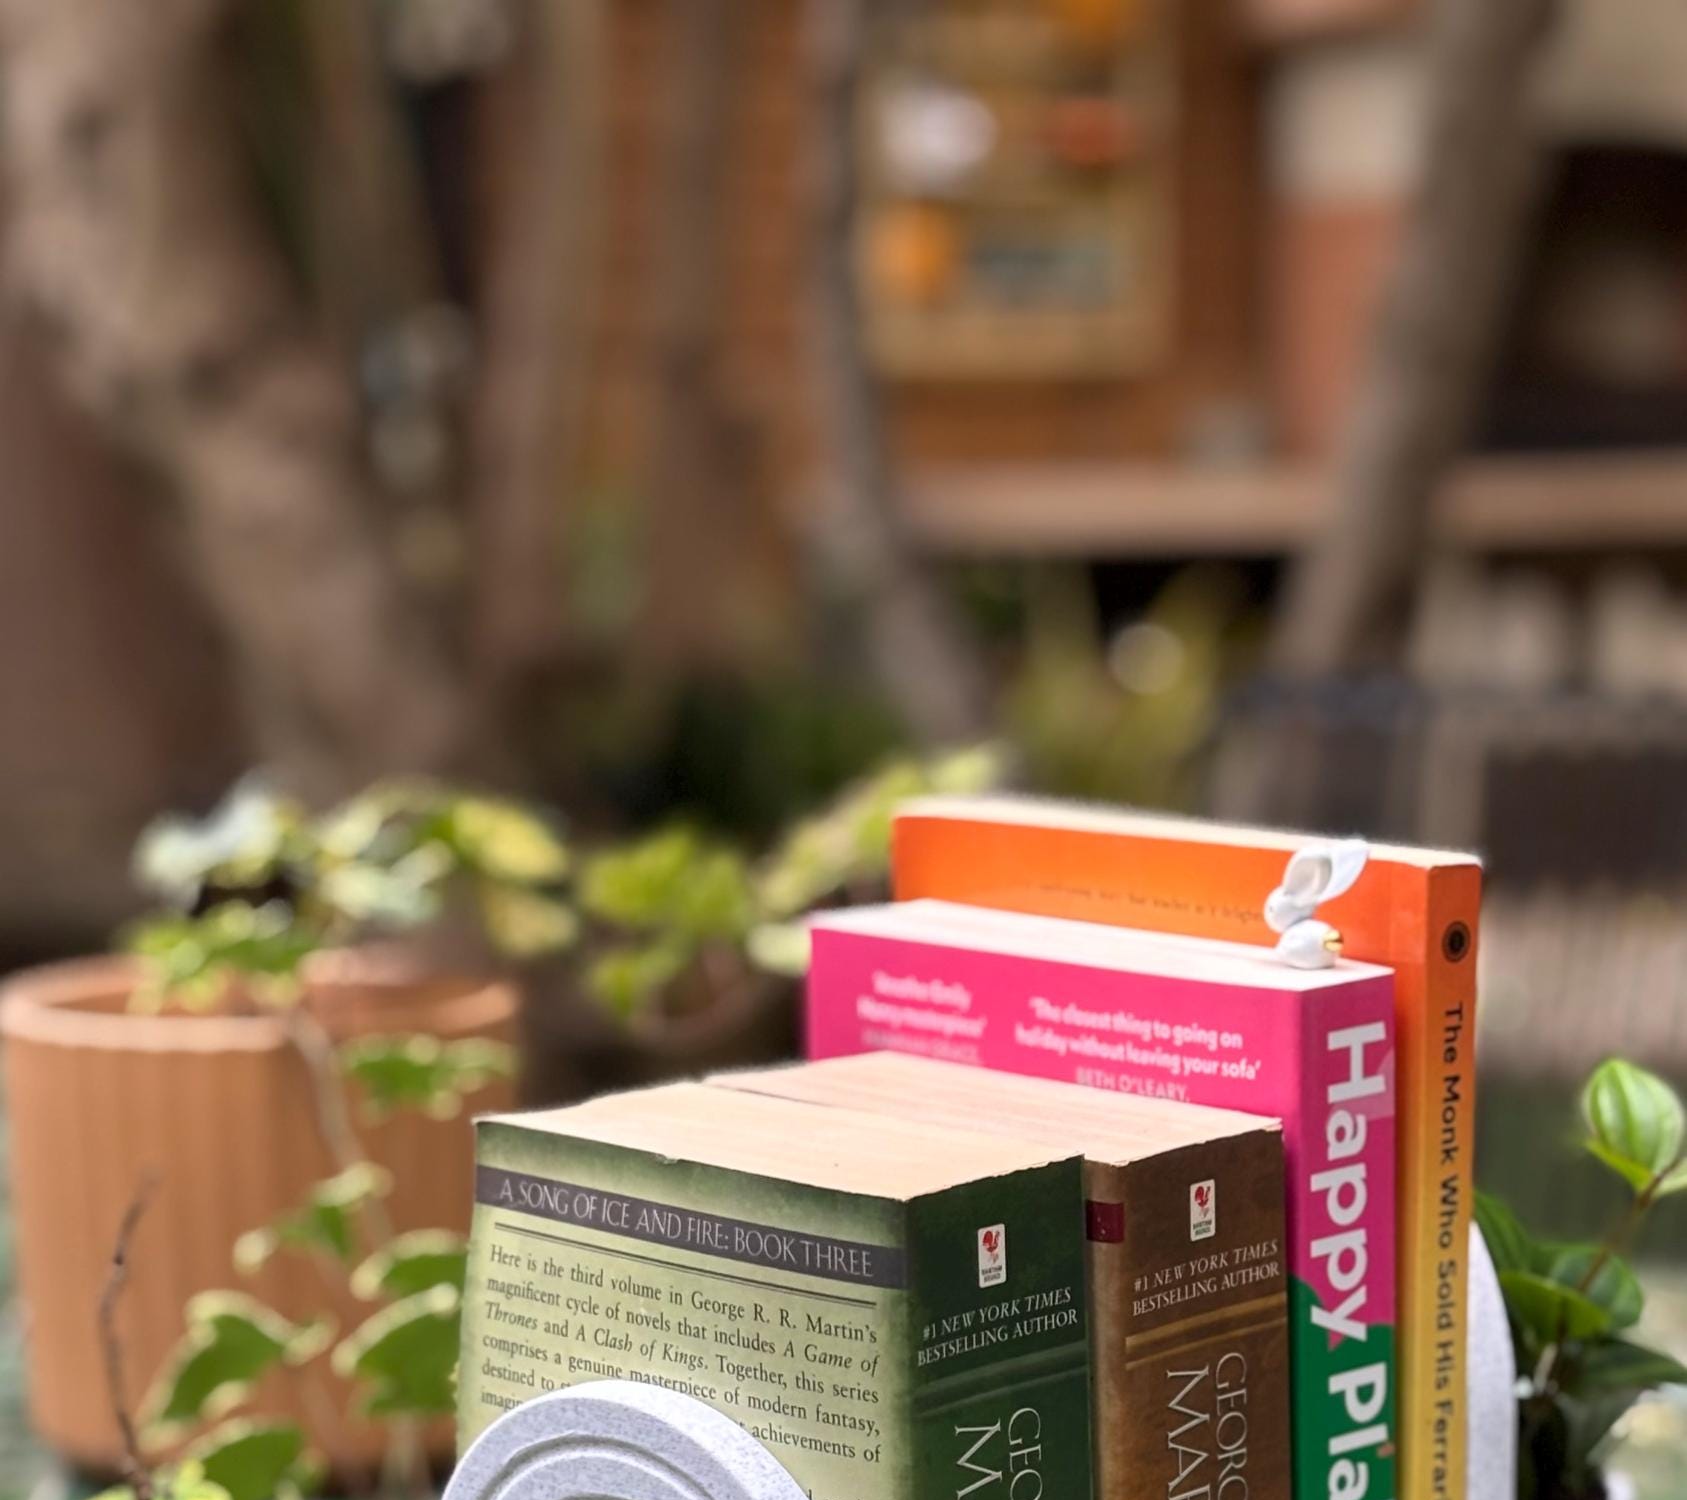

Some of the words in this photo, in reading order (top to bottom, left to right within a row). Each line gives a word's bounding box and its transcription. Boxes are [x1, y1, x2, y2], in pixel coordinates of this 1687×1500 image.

[1015, 1020, 1067, 1057] holiday
[1069, 1034, 1124, 1060] without
[1125, 1041, 1180, 1076] leaving
[1182, 1056, 1219, 1076] your
[1112, 1010, 1152, 1042] thing
[1153, 1020, 1171, 1039] to
[1173, 1022, 1218, 1051] going
[1220, 1031, 1243, 1049] on
[1442, 1001, 1463, 1064] The
[1076, 1066, 1116, 1091] BETH
[1441, 1074, 1461, 1165] Monk
[1310, 1021, 1387, 1343] Happy
[1438, 1173, 1460, 1250] Who
[499, 1179, 513, 1202] A
[519, 1181, 569, 1215] SONG
[574, 1193, 597, 1220] OF
[602, 1198, 630, 1228] ICE
[635, 1208, 681, 1239] AND
[687, 1217, 729, 1250] FIRE:
[734, 1226, 798, 1264] BOOK
[800, 1240, 874, 1277] THREE
[490, 1244, 521, 1267] Here
[527, 1253, 537, 1271] is
[543, 1258, 564, 1278] the
[570, 1263, 604, 1287] third
[611, 1276, 661, 1301] volume
[669, 1286, 683, 1306] in
[691, 1290, 745, 1321] George
[753, 1303, 770, 1323] R.
[779, 1308, 797, 1329] R.
[805, 1313, 877, 1344] Martin's
[1132, 1277, 1218, 1317] BESTSELLING
[1220, 1261, 1280, 1290] AUTHOR
[1133, 1277, 1148, 1293] #1
[1153, 1263, 1186, 1288] NEW
[1188, 1252, 1229, 1277] YORK
[1233, 1238, 1279, 1265] TIMES
[1436, 1259, 1457, 1332] Sold
[487, 1277, 560, 1306] magnificent
[566, 1295, 600, 1316] cycle
[605, 1302, 620, 1321] of
[626, 1311, 671, 1333] novels
[677, 1317, 707, 1340] that
[714, 1324, 775, 1355] includes
[783, 1340, 795, 1358] A
[804, 1344, 852, 1369] Game
[860, 1355, 880, 1378] of
[918, 1325, 1008, 1367] BESTSELLING
[1012, 1308, 1078, 1339] AUTHOR
[923, 1325, 936, 1341] #1
[941, 1310, 976, 1336] NEW
[979, 1299, 1020, 1324] YORK
[1025, 1287, 1072, 1313] TIMES
[483, 1334, 548, 1361] comprises
[554, 1352, 562, 1365] a
[568, 1355, 623, 1379] genuine
[629, 1368, 717, 1400] masterpiece
[724, 1387, 740, 1405] of
[748, 1395, 807, 1420] modern
[815, 1403, 880, 1437] fantasy,
[485, 1300, 538, 1330] Thrones
[544, 1320, 569, 1338] and
[575, 1325, 586, 1342] A
[594, 1328, 633, 1352] Clash
[639, 1340, 657, 1362] of
[662, 1343, 708, 1371] Kings.
[715, 1354, 787, 1389] Together,
[795, 1371, 825, 1394] this
[832, 1382, 879, 1404] series
[1435, 1341, 1455, 1391] His
[482, 1358, 535, 1387] destined
[541, 1376, 555, 1391] to
[752, 1422, 856, 1459] achievements
[863, 1444, 881, 1463] of
